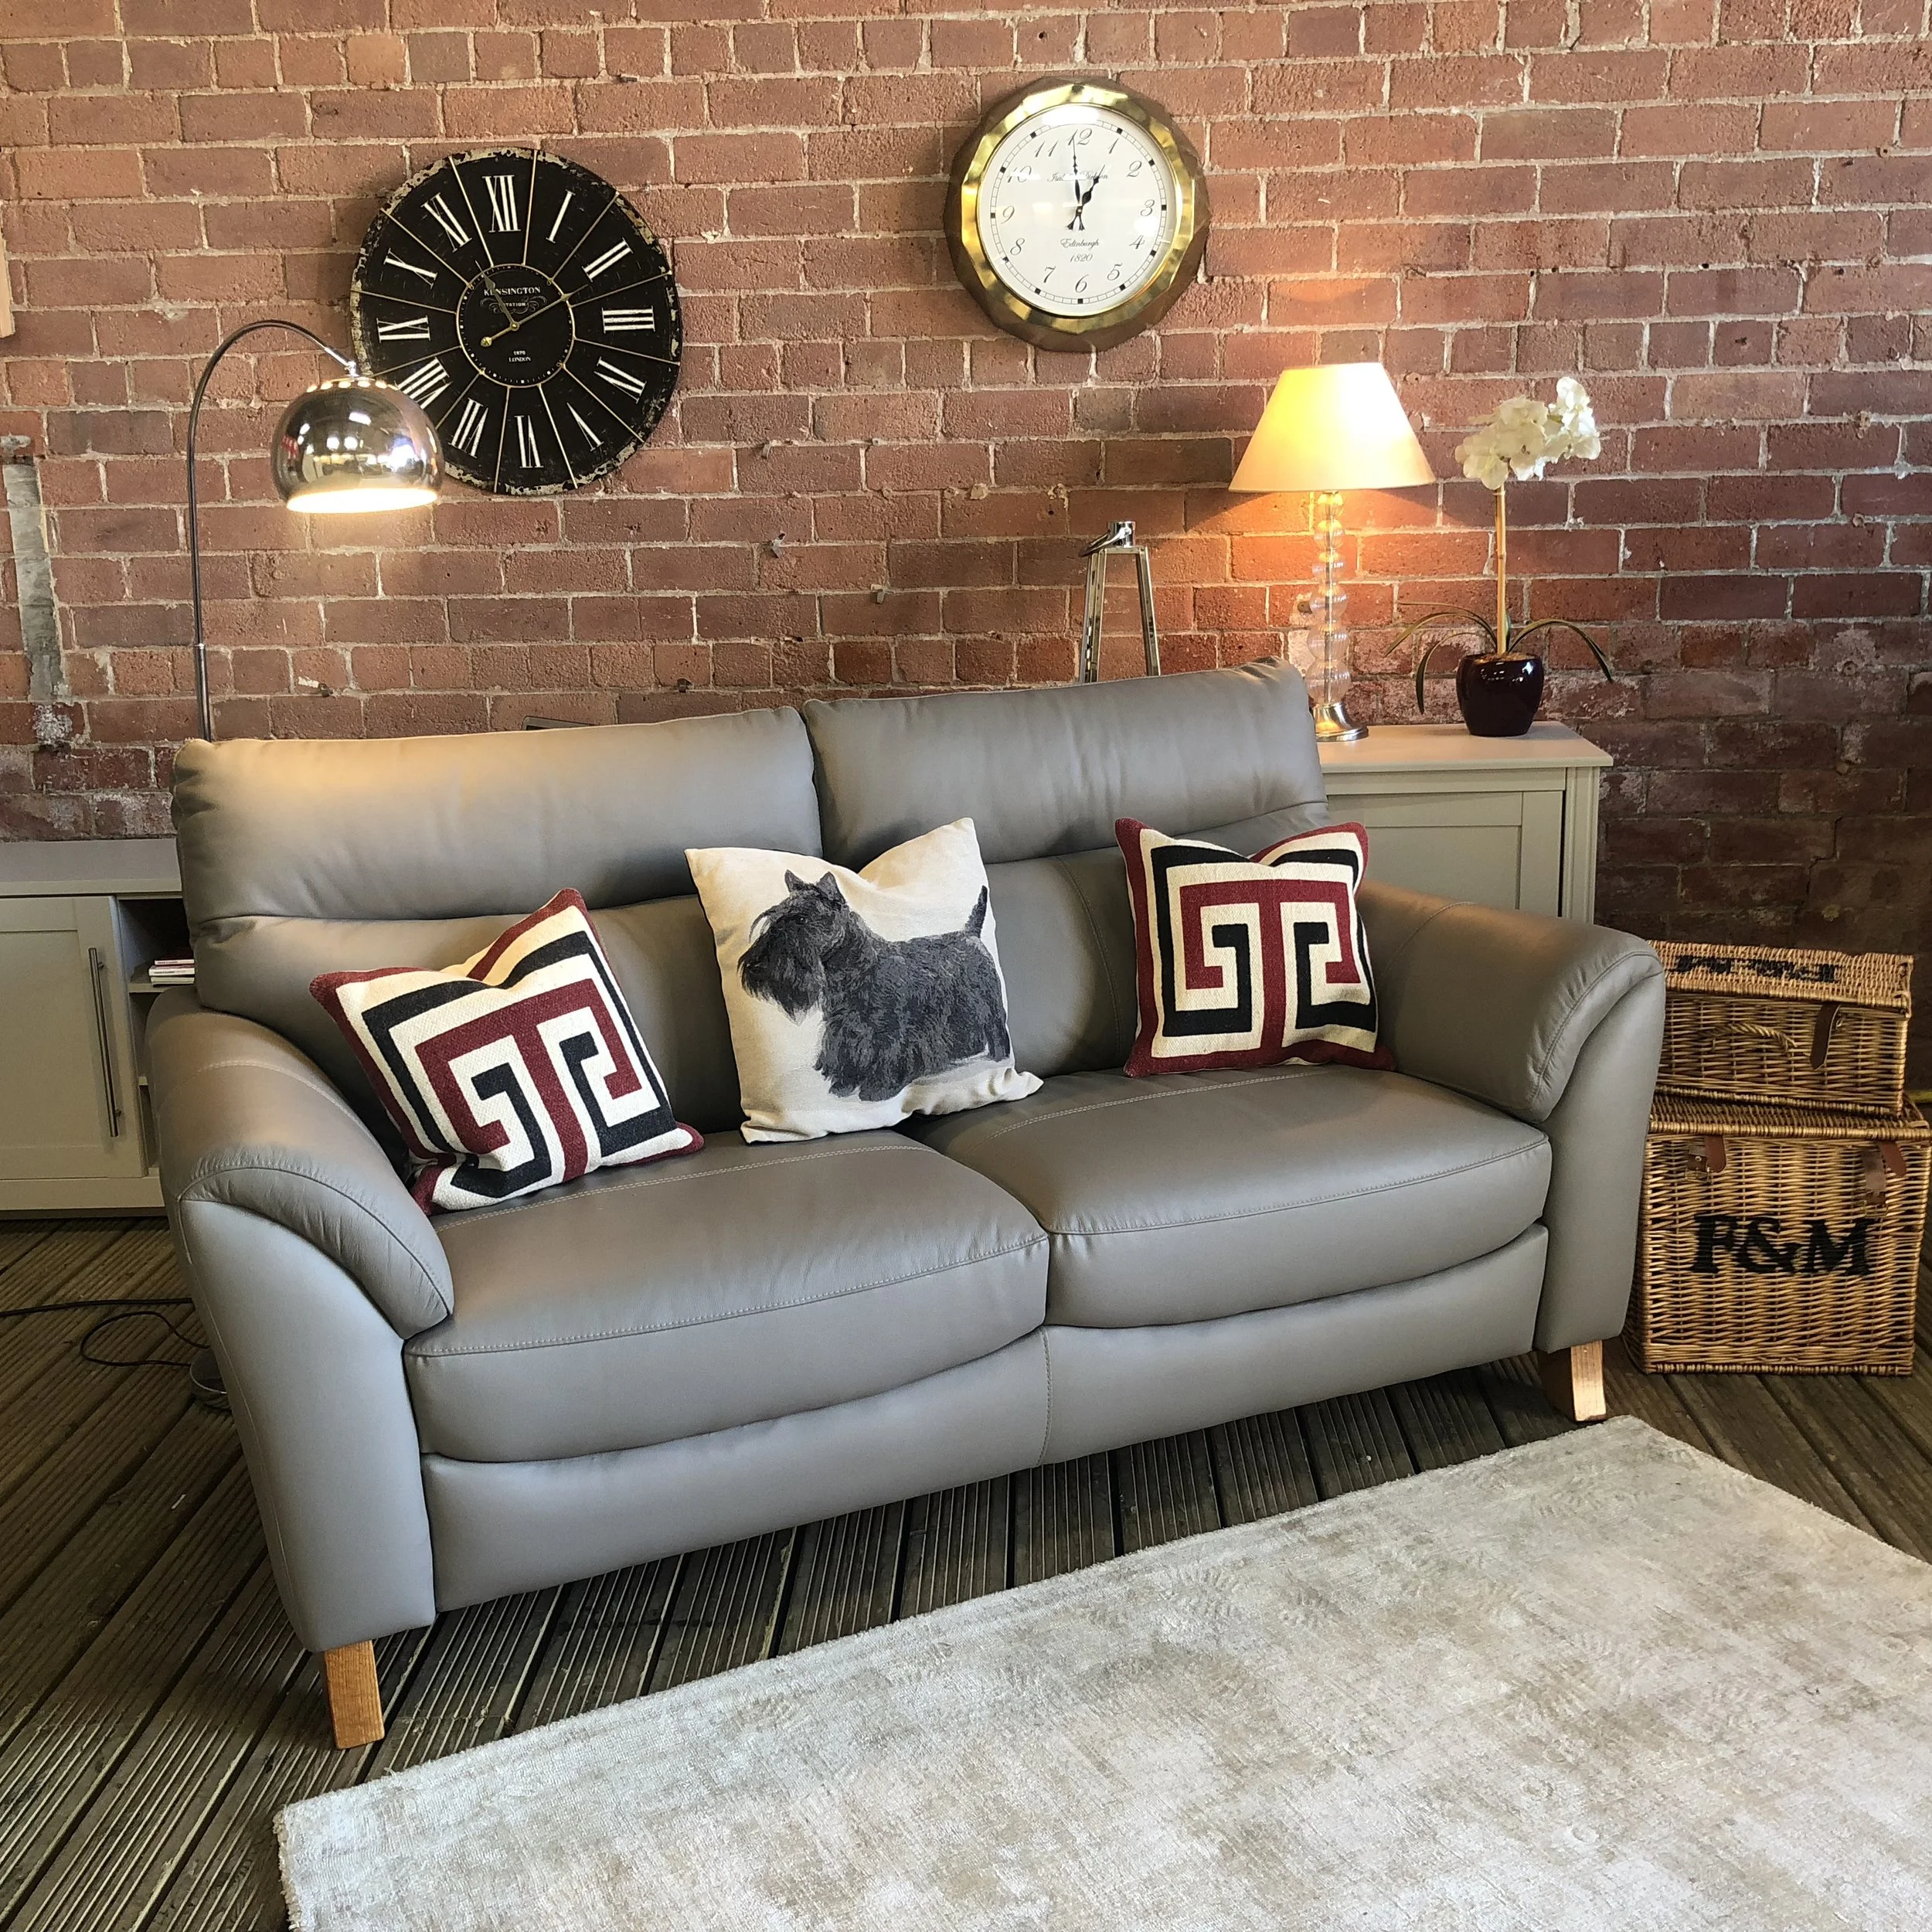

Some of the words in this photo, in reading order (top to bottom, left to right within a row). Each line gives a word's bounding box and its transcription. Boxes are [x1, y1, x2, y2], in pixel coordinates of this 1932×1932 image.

[1067, 128, 1094, 146] 12
[1107, 138, 1120, 155] 1
[1034, 139, 1059, 158] 11
[1126, 160, 1143, 178] 2
[482, 174, 522, 233] XII
[1140, 199, 1155, 216] 3
[420, 192, 472, 253] XI
[1000, 206, 1015, 224] 9
[1009, 237, 1026, 256] 8
[1060, 238, 1099, 250] Edinburgh
[1129, 235, 1146, 250] 4
[582, 237, 633, 282] II
[1070, 253, 1093, 263] 1820
[383, 247, 439, 291] X
[1042, 266, 1057, 284] 7
[1107, 263, 1124, 281] 5
[1074, 274, 1088, 294] 6
[376, 315, 431, 342] IX
[601, 305, 656, 334] III
[593, 355, 648, 405] IV
[566, 401, 605, 452] V
